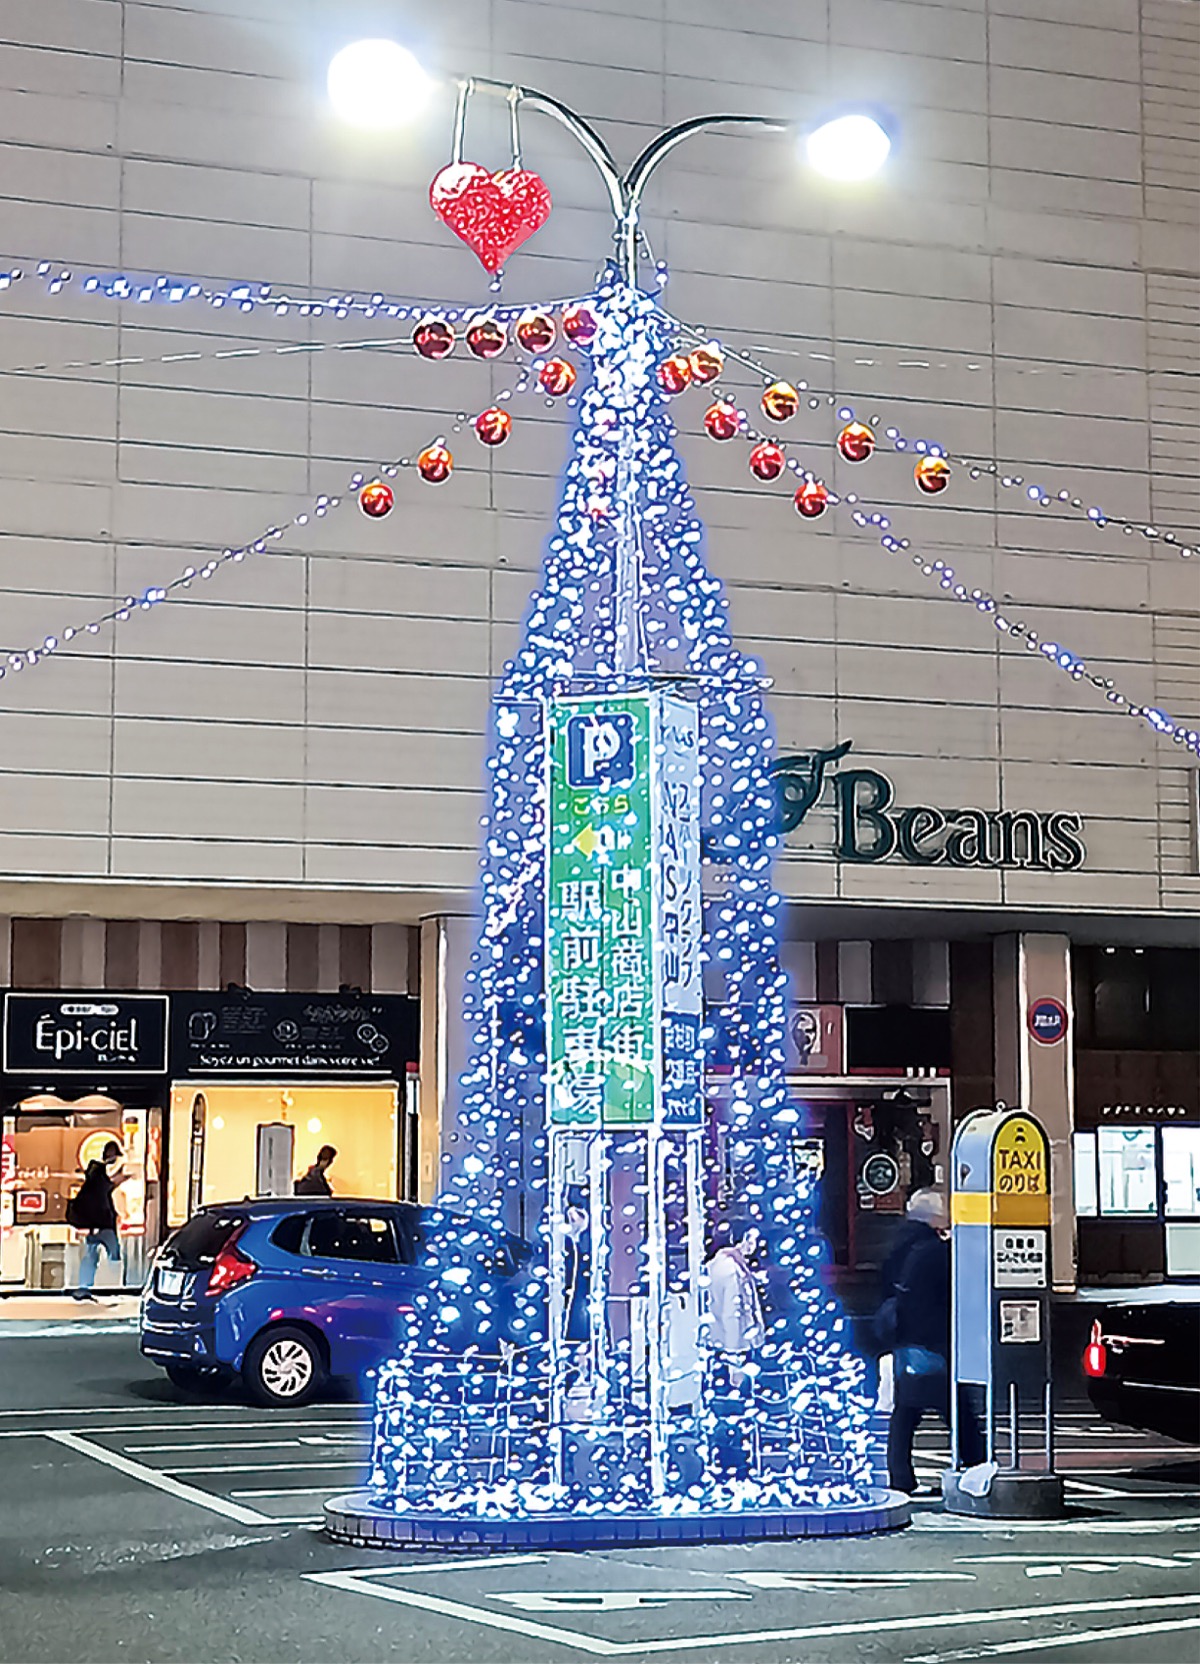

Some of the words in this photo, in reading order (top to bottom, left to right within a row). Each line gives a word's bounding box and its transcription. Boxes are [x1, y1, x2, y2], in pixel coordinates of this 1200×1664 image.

[833, 767, 1087, 871] Beans
[998, 1149, 1041, 1170] TAXI
[998, 1172, 1041, 1193] のりば
